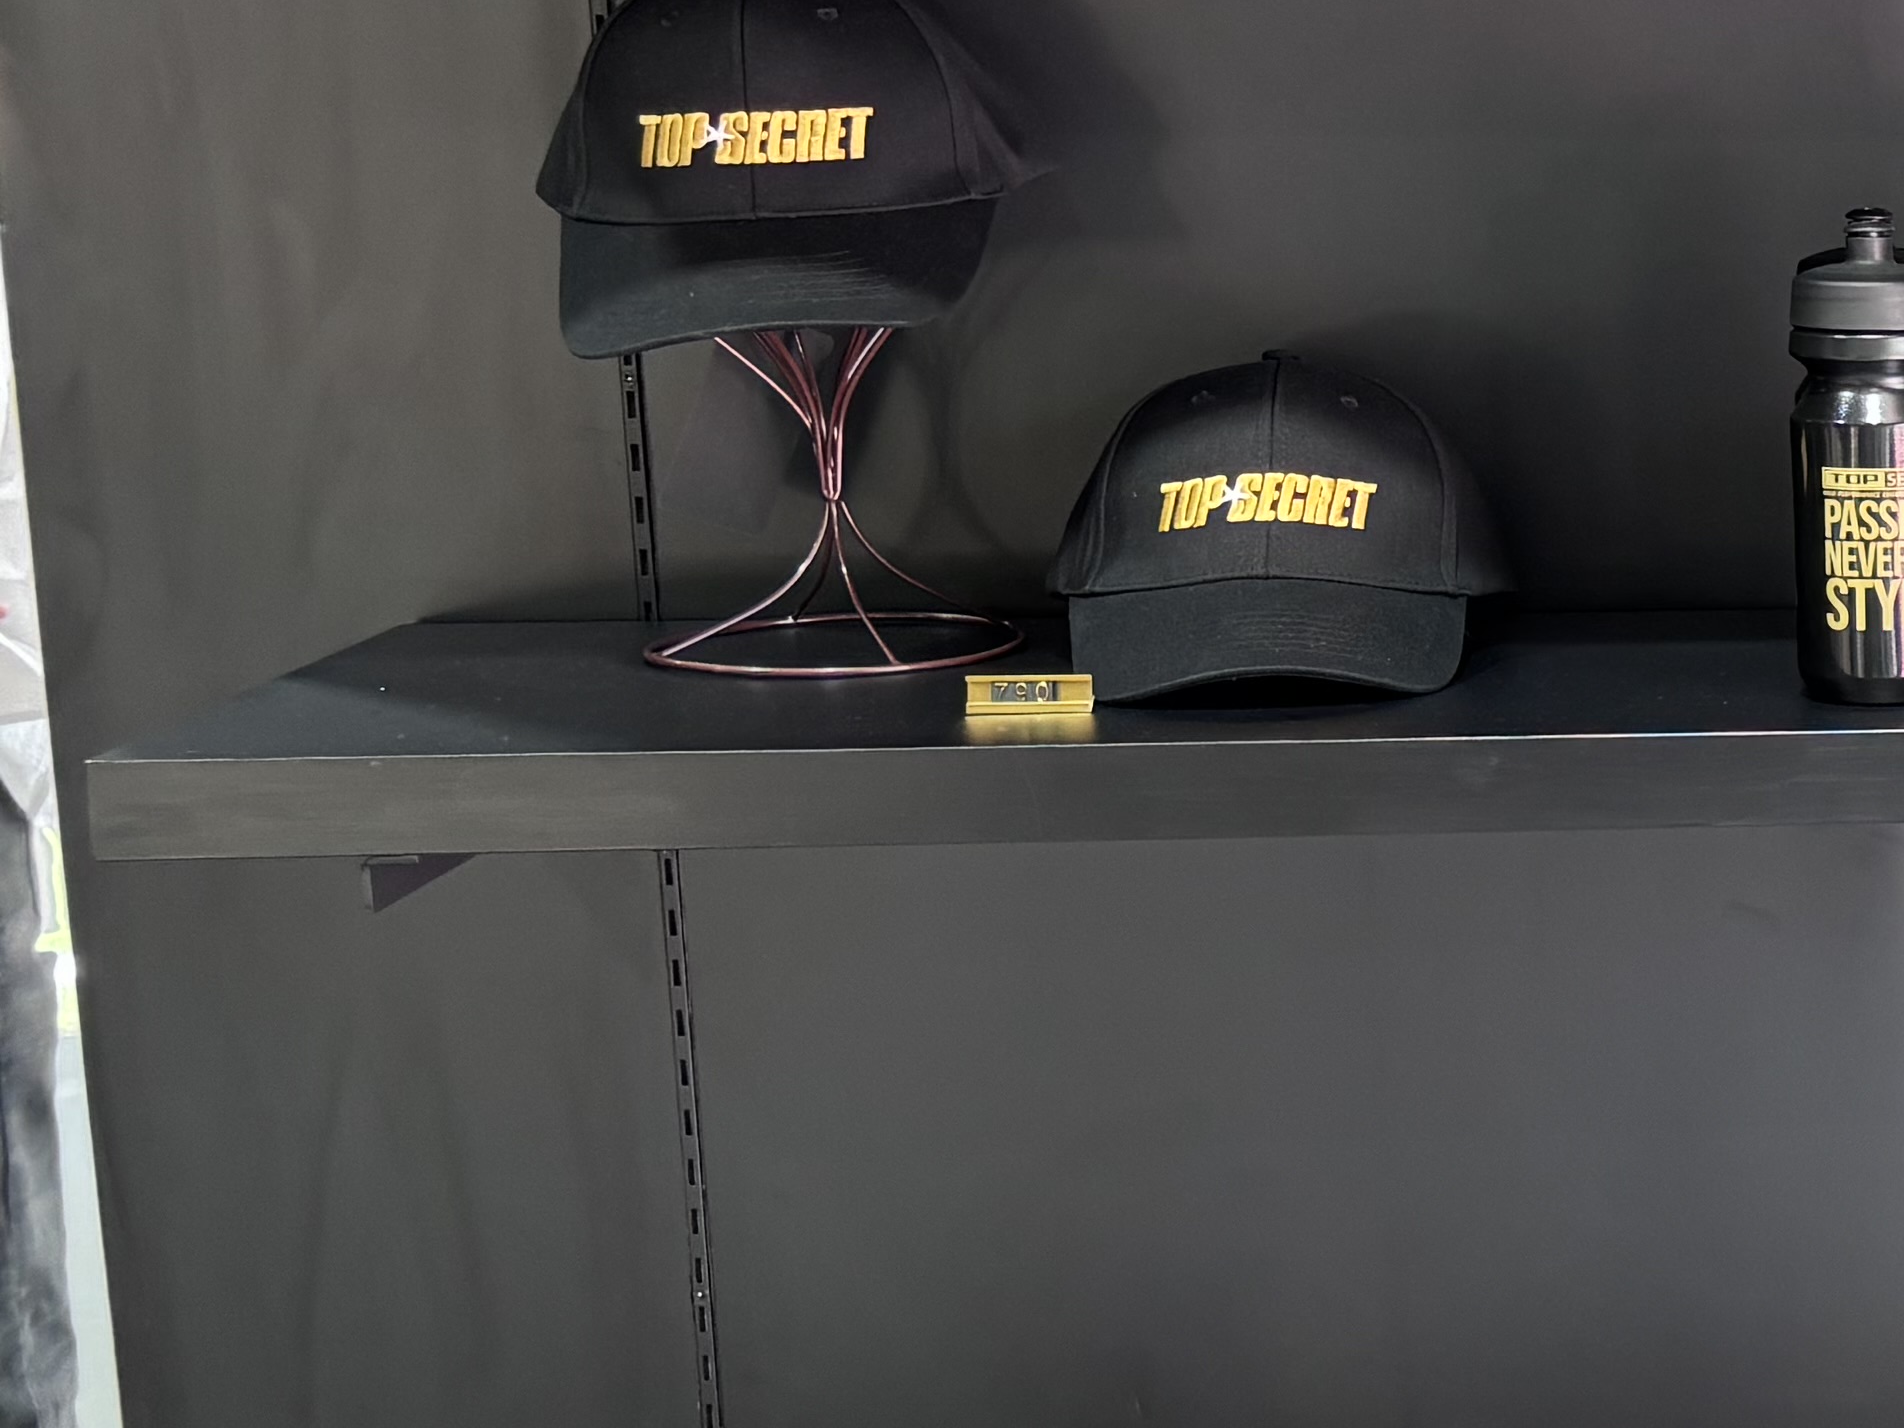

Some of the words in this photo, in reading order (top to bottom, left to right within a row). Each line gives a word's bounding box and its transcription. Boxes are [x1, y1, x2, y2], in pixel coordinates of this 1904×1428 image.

[639, 112, 711, 168] TOP
[714, 106, 874, 166] SECRET
[1158, 475, 1229, 532] TOP
[1226, 472, 1378, 529] SECRET
[1832, 473, 1879, 485] TOP
